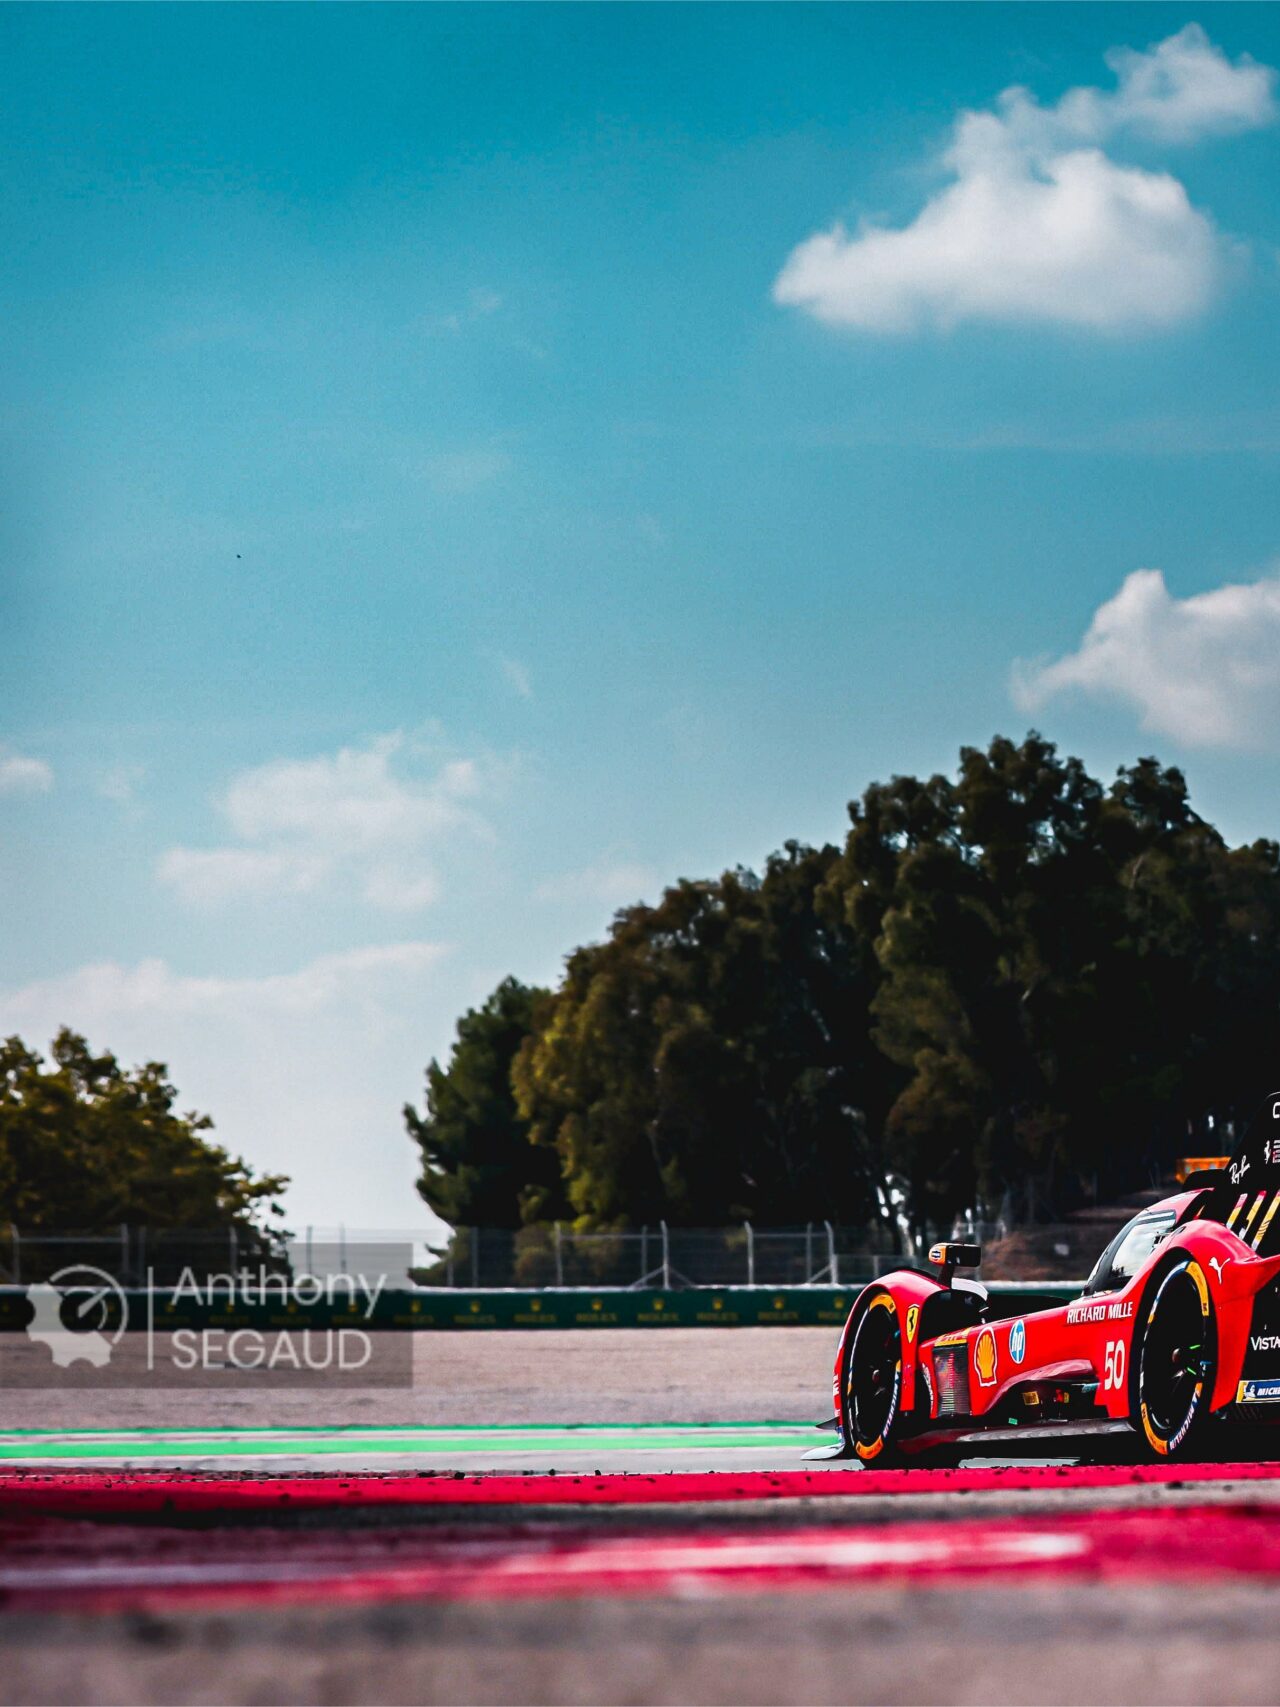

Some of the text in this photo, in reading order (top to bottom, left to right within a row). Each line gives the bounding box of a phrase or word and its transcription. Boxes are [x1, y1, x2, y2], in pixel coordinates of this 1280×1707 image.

[1066, 1301, 1133, 1325] RICHARD MILLE
[1104, 1339, 1126, 1391] 50
